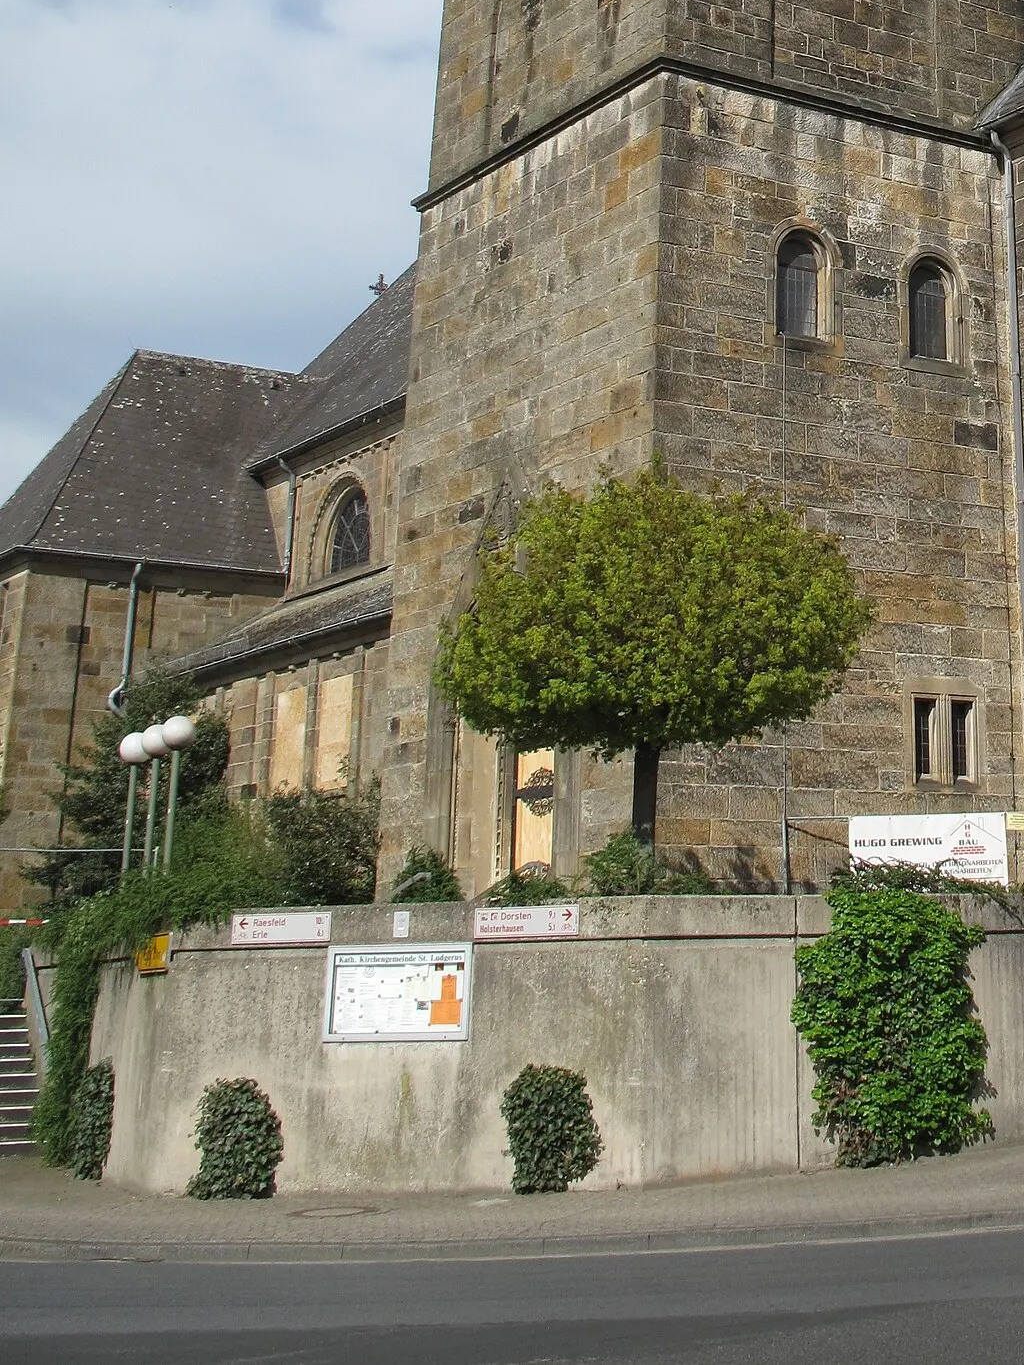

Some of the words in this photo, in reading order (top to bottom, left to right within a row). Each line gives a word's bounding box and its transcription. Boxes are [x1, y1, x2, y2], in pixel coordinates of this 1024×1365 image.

[854, 838, 886, 848] HUGO
[890, 836, 943, 847] GREWING
[958, 838, 978, 846] BAU
[500, 911, 532, 921] Dorsten
[253, 917, 286, 927] Raesfeld
[479, 923, 524, 933] Holsterhausen
[252, 930, 268, 939] Erle
[338, 955, 357, 963] Kath.
[359, 953, 417, 963] Kirchengemeinde
[418, 954, 429, 962] St.
[430, 952, 463, 962] Ludgerus
